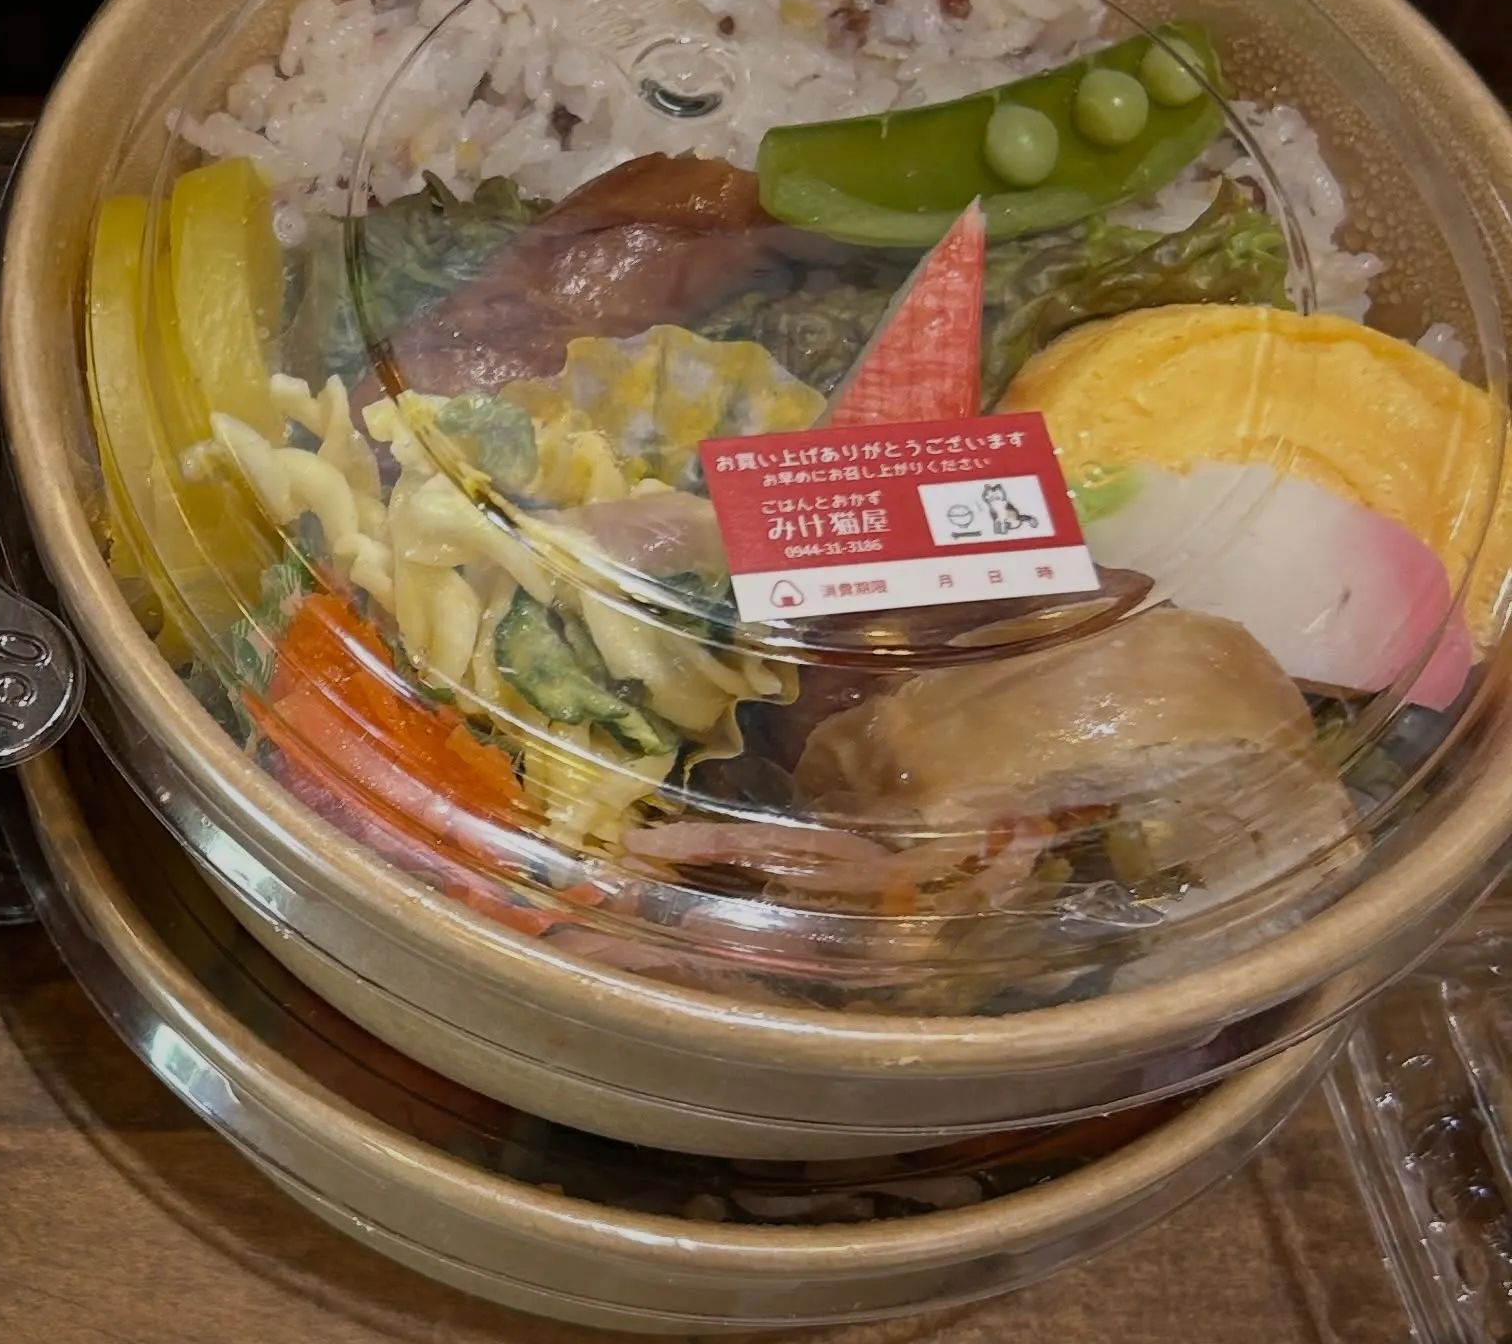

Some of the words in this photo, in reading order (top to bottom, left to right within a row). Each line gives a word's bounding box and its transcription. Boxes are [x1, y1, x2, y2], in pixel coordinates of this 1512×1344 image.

[715, 431, 1027, 472] お買い上げありがとうございます
[762, 457, 991, 487] お早めにお召し上がりください
[760, 490, 883, 515] ごはんとおかず
[767, 508, 891, 542] みけ猫屋
[821, 579, 889, 599] 消費期限
[937, 574, 954, 590] 月
[988, 570, 1003, 585] 日
[1035, 565, 1054, 581] 時
